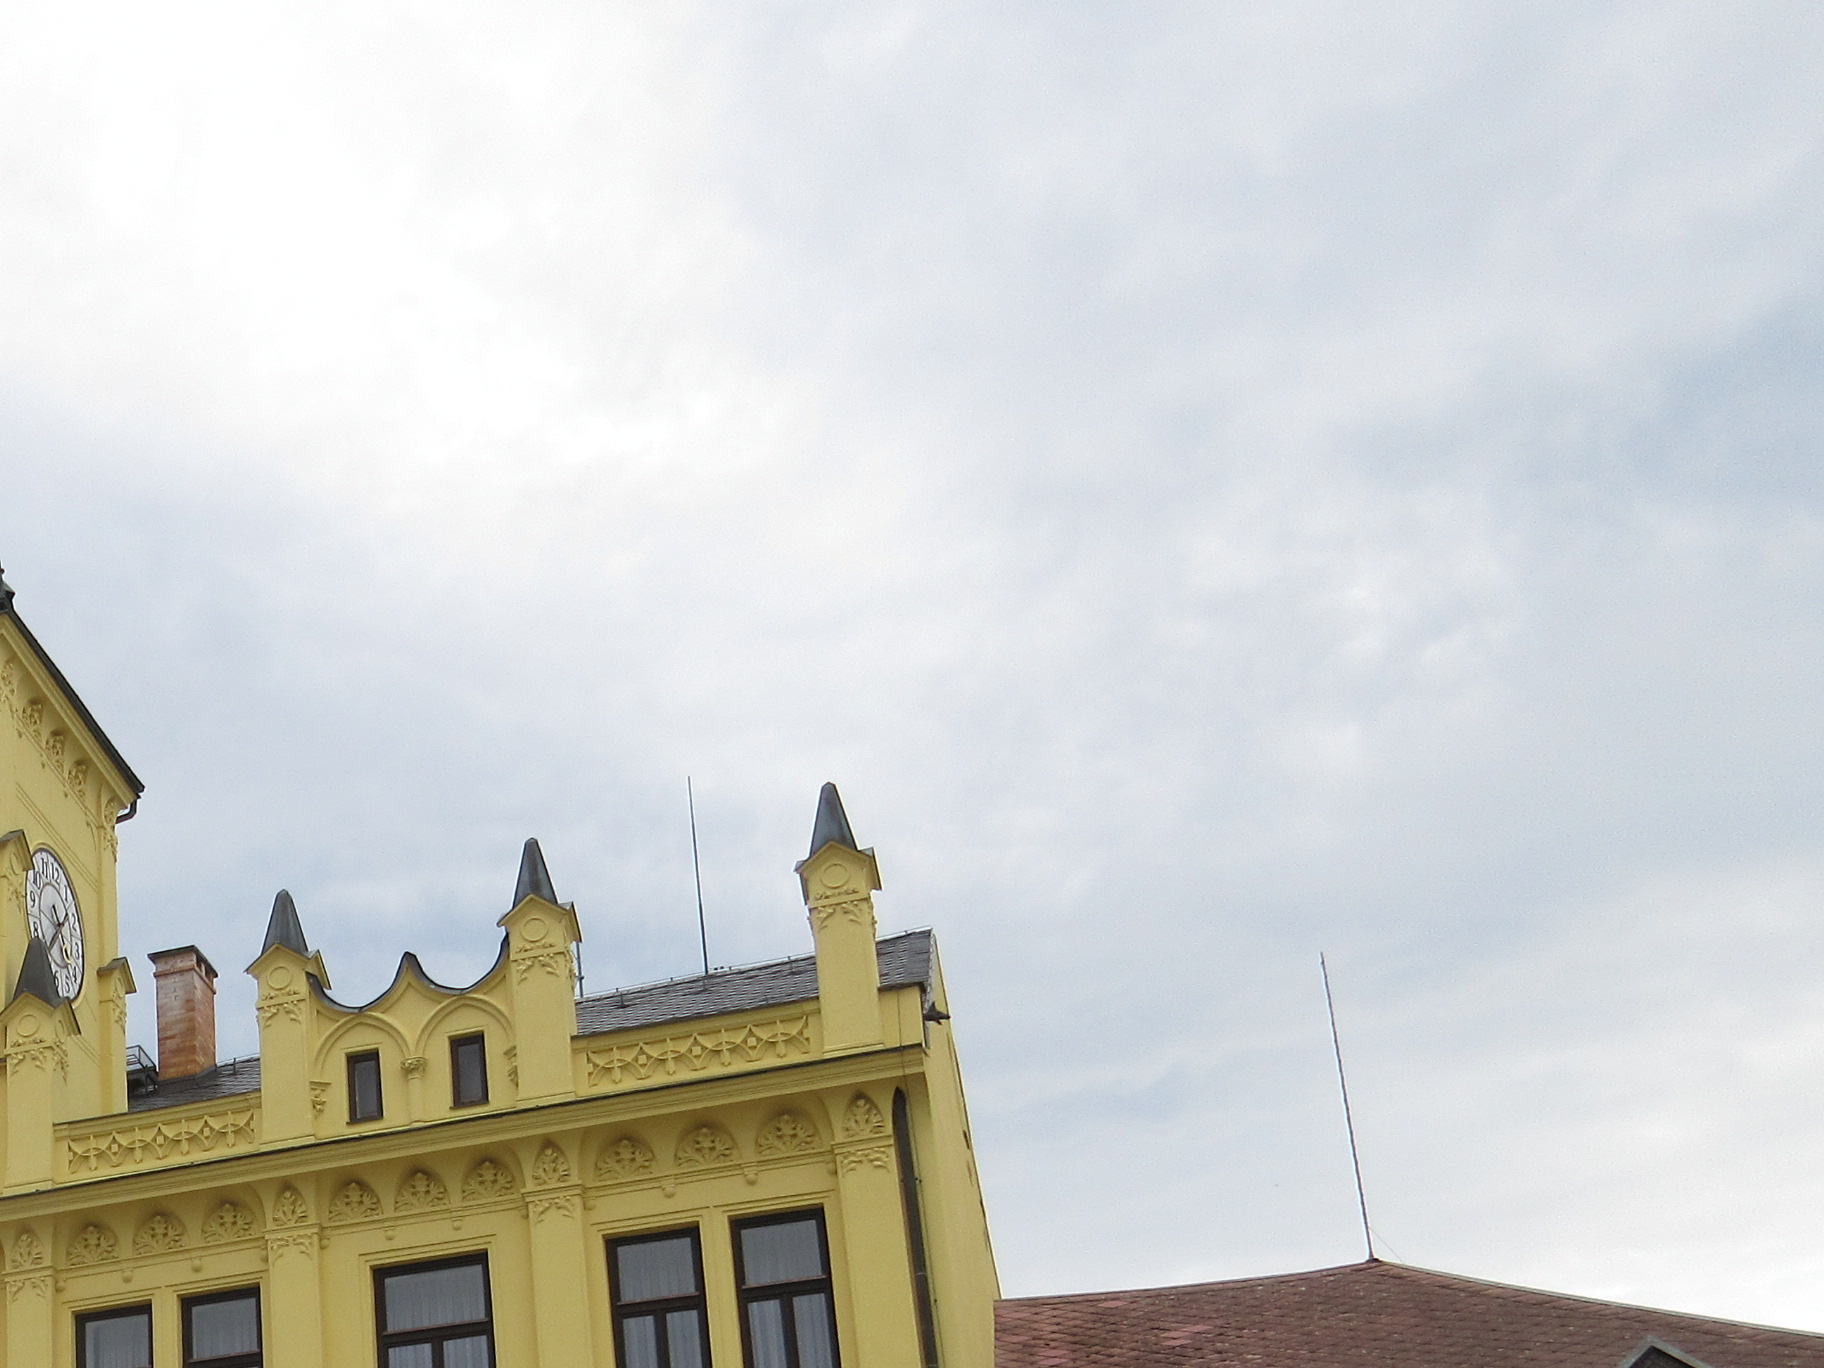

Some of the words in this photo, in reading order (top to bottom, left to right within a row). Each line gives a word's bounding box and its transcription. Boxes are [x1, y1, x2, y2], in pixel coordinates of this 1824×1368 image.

[50, 861, 60, 887] 12
[29, 890, 36, 908] 9
[71, 912, 77, 933] 2
[74, 941, 80, 961] 3
